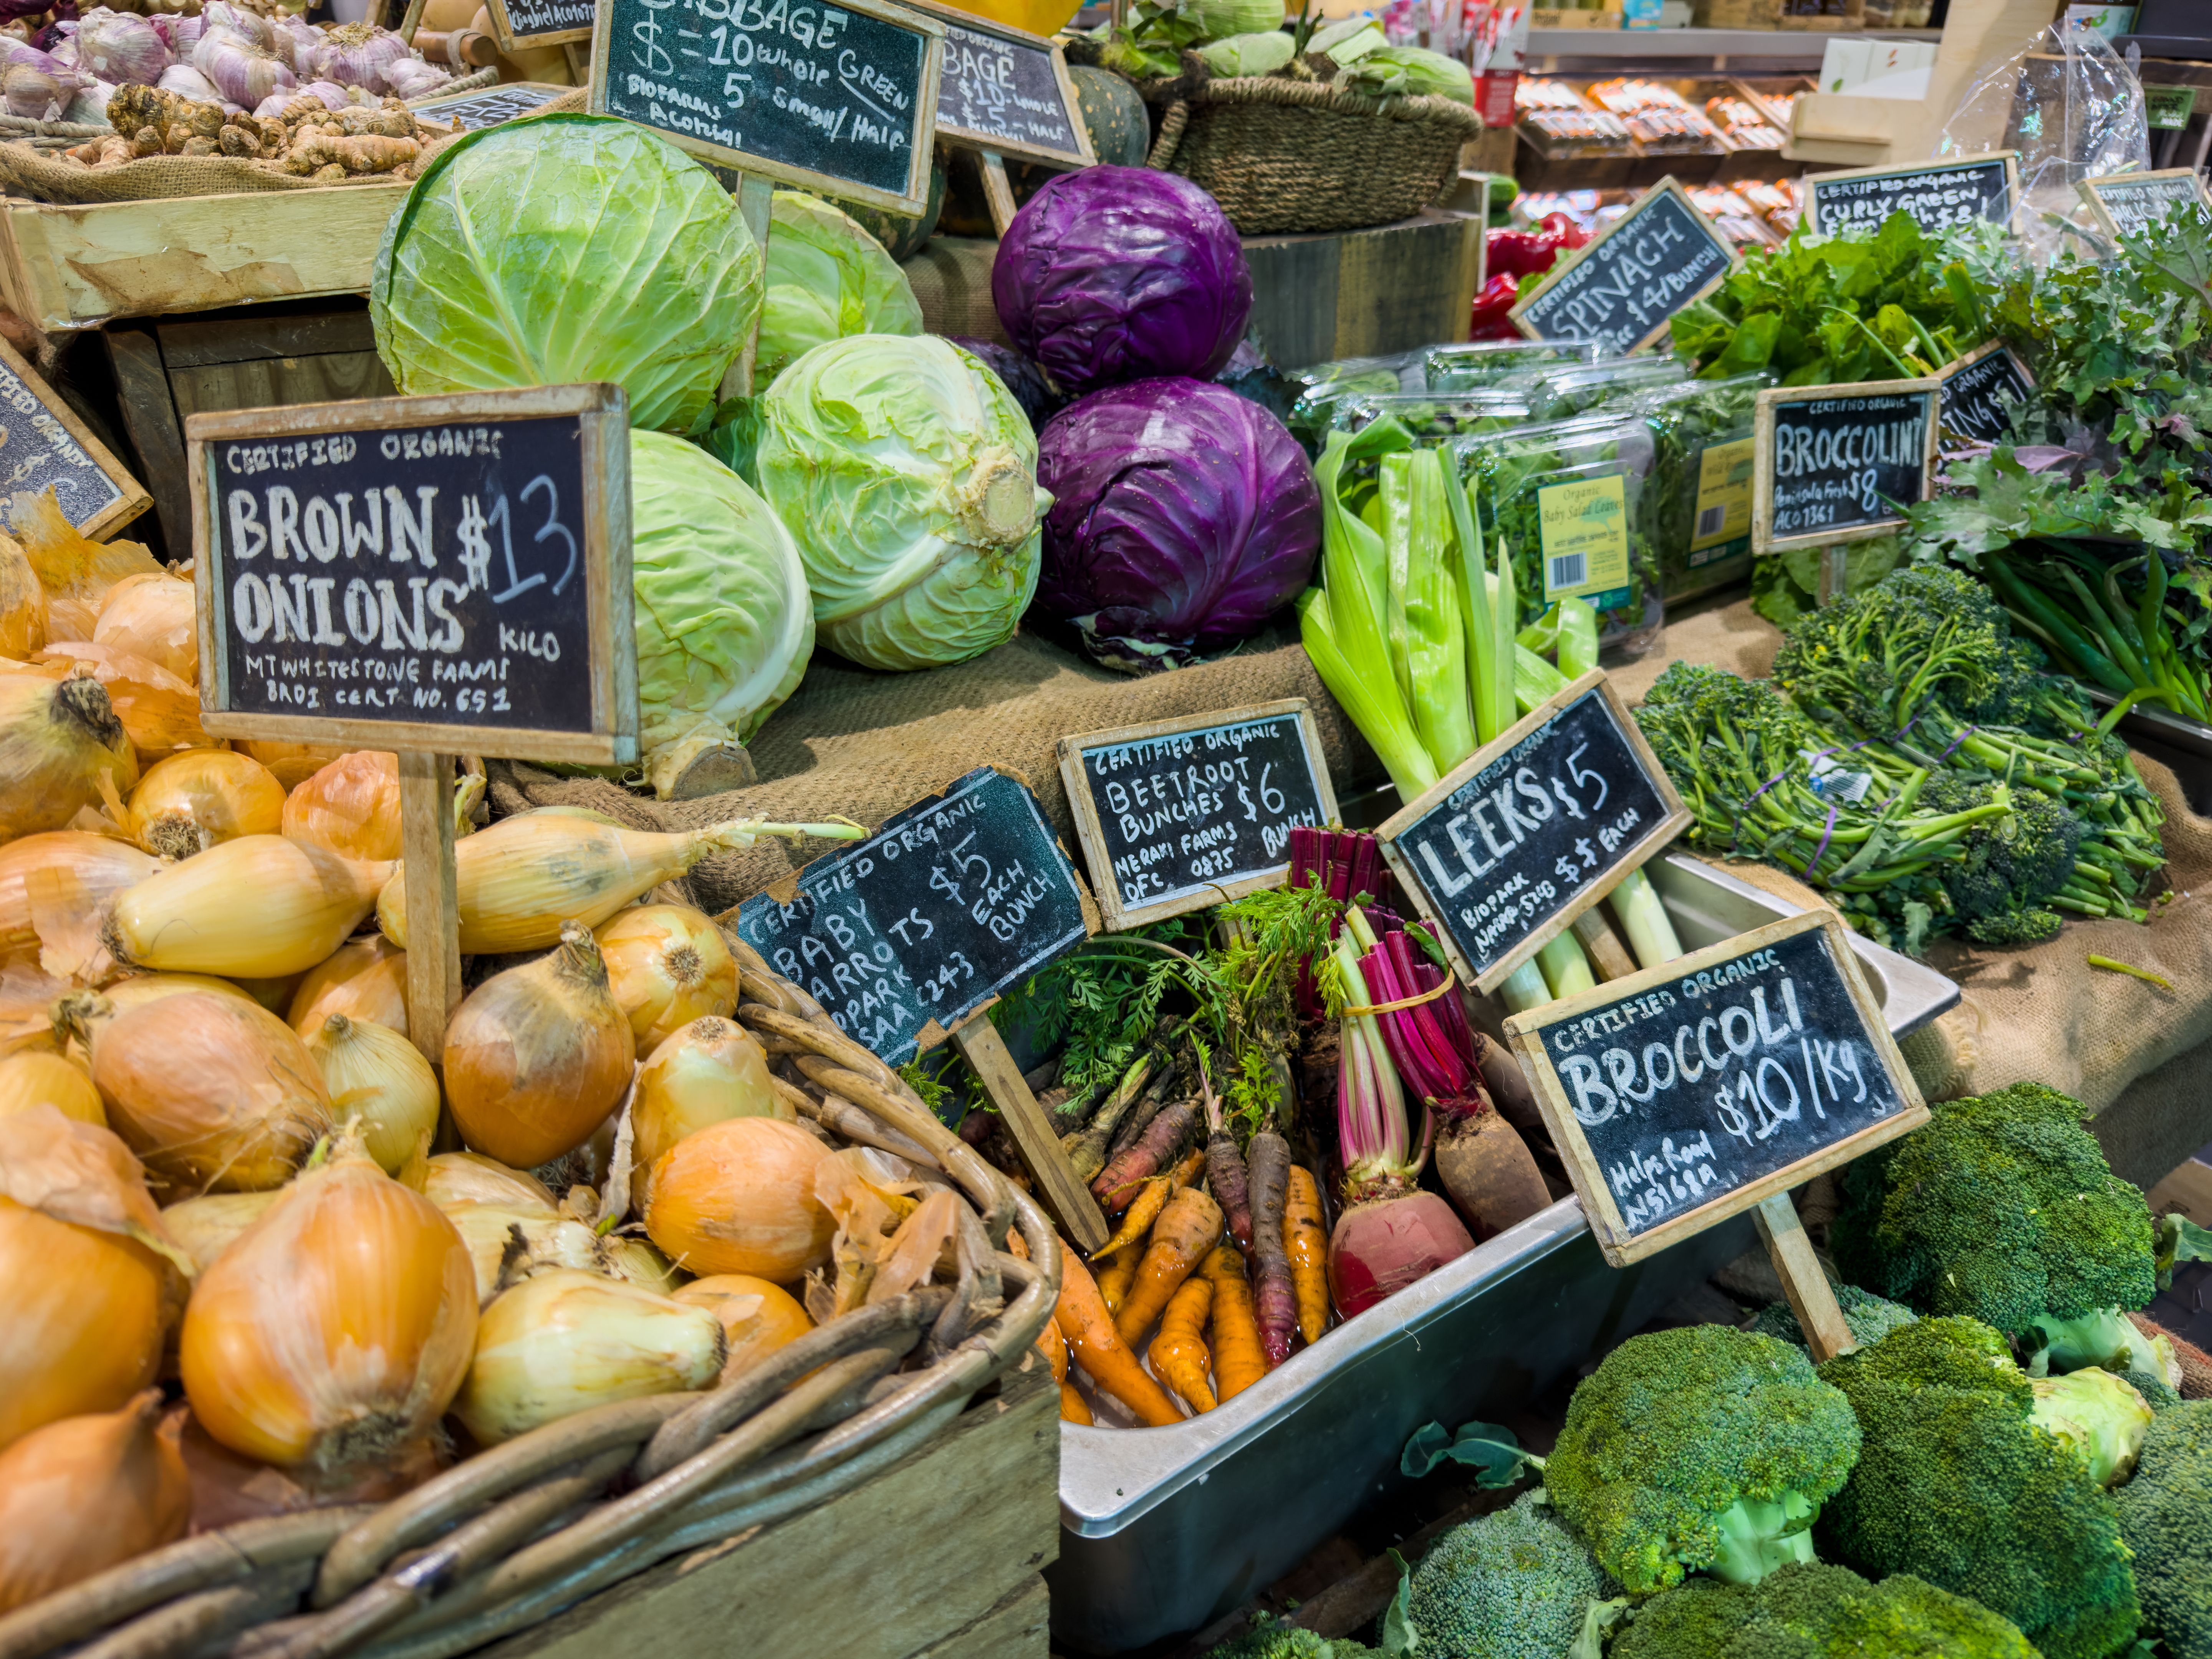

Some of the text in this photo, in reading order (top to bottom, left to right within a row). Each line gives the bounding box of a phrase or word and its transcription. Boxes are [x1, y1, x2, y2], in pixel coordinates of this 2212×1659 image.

[639, 0, 848, 49] BBAGE
[708, 25, 753, 66] 10
[724, 73, 752, 108] 5
[838, 49, 909, 110] GREEN
[941, 39, 1016, 89] BAGE
[1525, 260, 1595, 323] CERTIFIED
[1551, 216, 1685, 344] SPINACH
[227, 428, 503, 474] CERTIFIED ORGANIC
[1775, 417, 1921, 477] BROCCOLINI
[1543, 500, 1624, 525] Baby Salad Leaves
[1563, 486, 1601, 502] Organic
[228, 485, 438, 568] BROWN
[233, 572, 469, 654] ONIONS
[498, 623, 560, 661] KILO
[336, 687, 399, 707] CERT
[432, 657, 510, 684] FARMS
[1095, 724, 1280, 775] CERTIFIED ORGANIC
[1106, 757, 1249, 813] BEETROOT
[1120, 791, 1223, 843] BUNCHES
[1181, 821, 1237, 856] FARMS
[1417, 767, 1554, 899] LEEKS
[1598, 807, 1641, 853] EACH
[750, 795, 986, 944] CERTIFIED ORGANIC
[930, 831, 992, 906] $5
[972, 860, 1027, 926] EACH
[989, 868, 1056, 942] BUNCH
[773, 898, 875, 984] BABY
[831, 964, 911, 1031] OPARK
[1554, 949, 1780, 1053] CERTIFIED ORGANIC
[859, 1002, 915, 1051] SAA
[1559, 977, 1804, 1126] BROCCOLI
